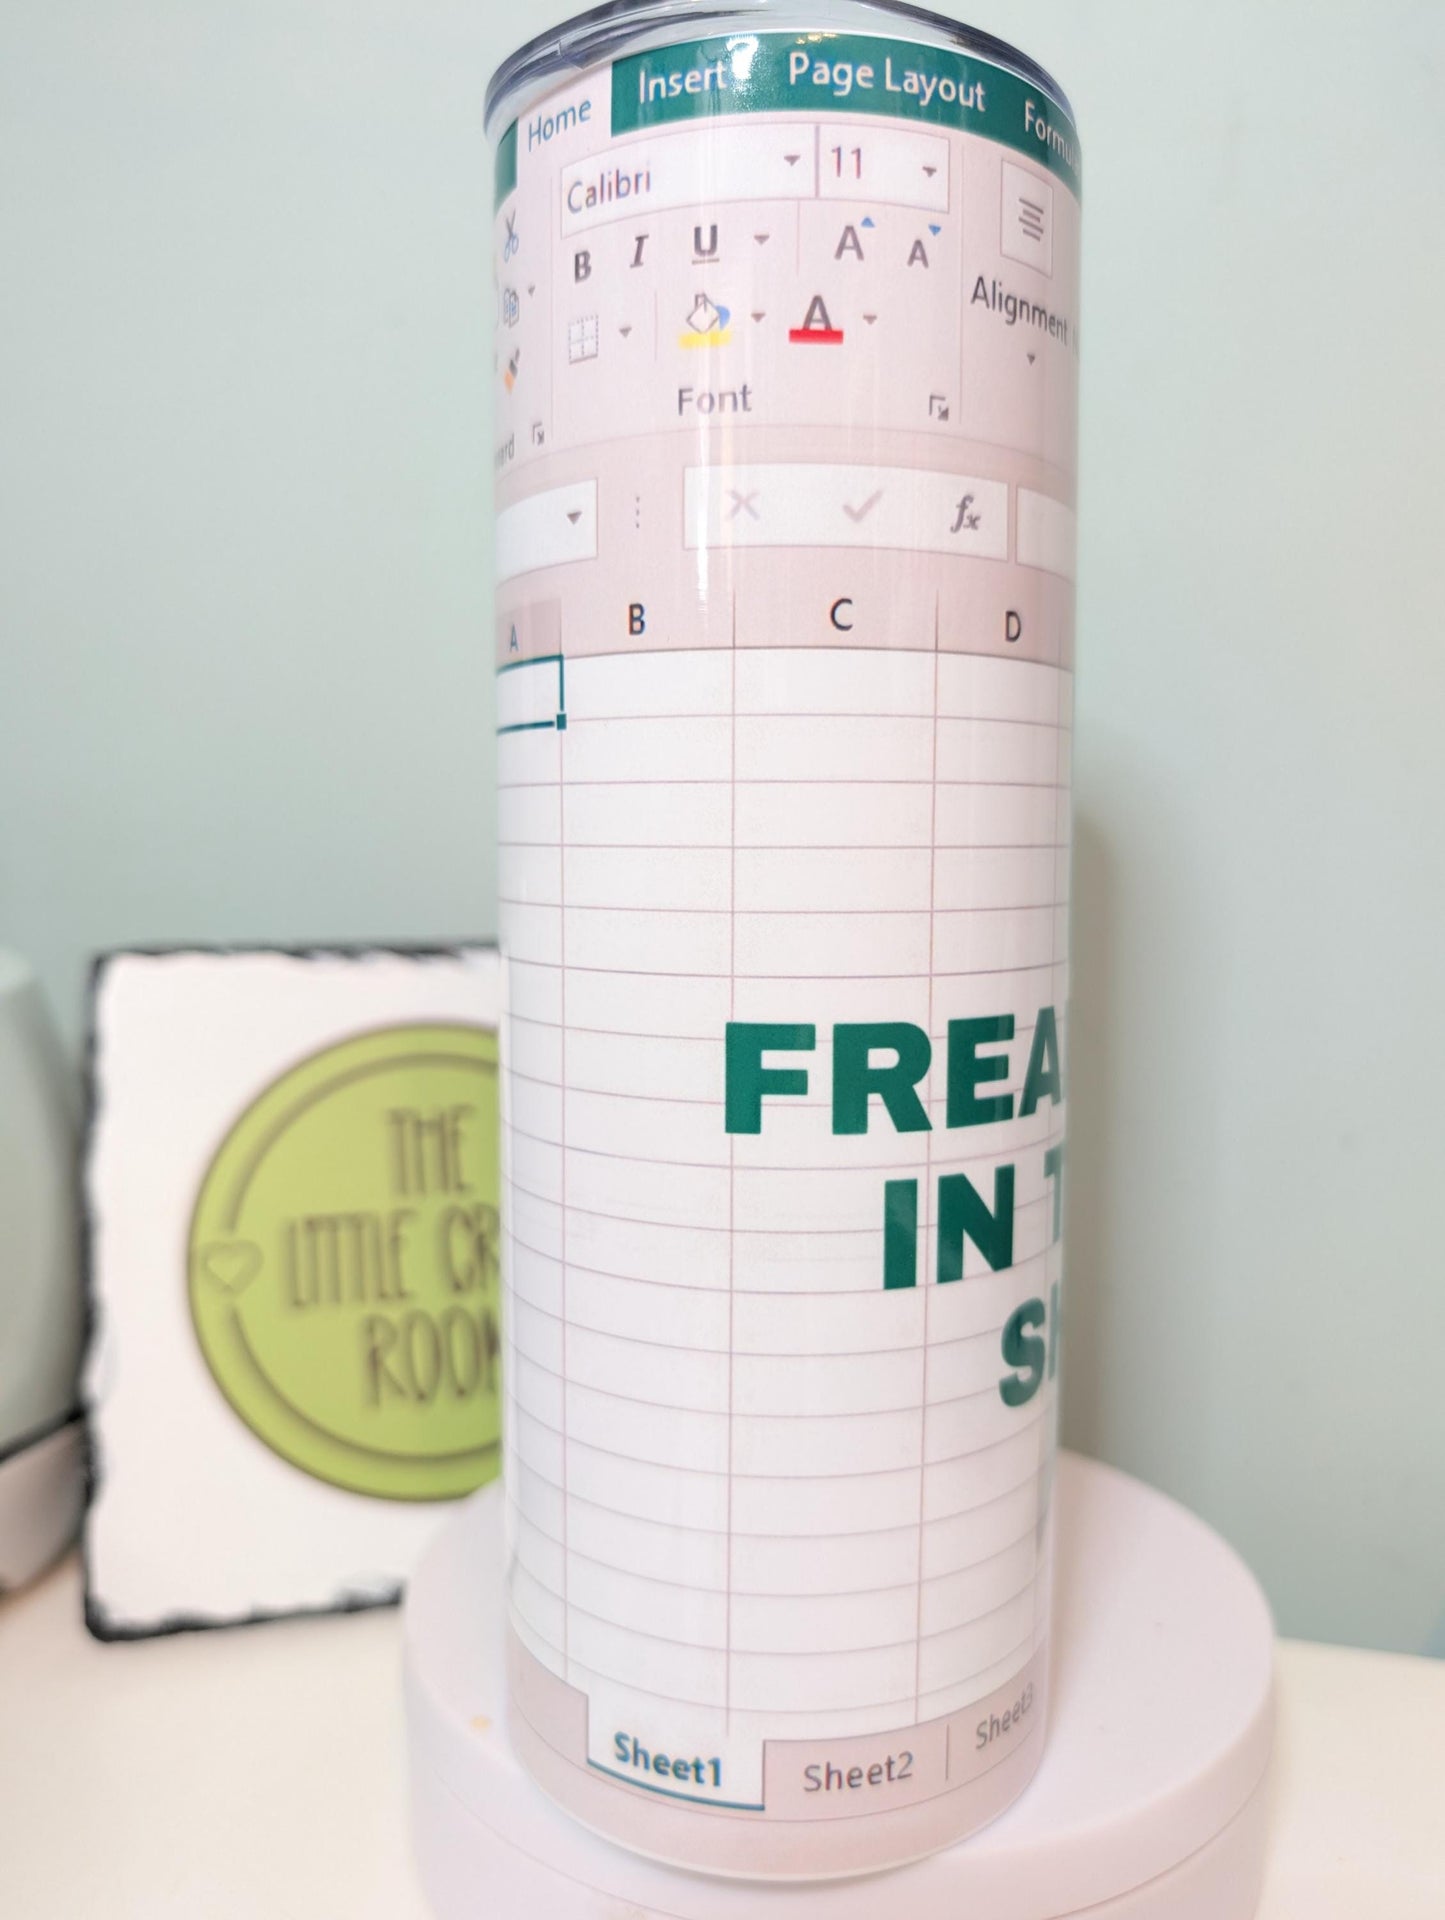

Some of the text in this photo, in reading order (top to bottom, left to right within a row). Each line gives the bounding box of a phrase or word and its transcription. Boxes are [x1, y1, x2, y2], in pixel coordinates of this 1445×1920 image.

[528, 51, 1079, 176] Home Insert Page Layout Formul
[566, 145, 864, 214] Calibri 11
[573, 223, 931, 283] B I U A A
[801, 294, 835, 331] A
[970, 274, 1068, 346] Alignment
[677, 383, 753, 416] Font
[949, 493, 981, 533] fx
[508, 597, 1023, 652] A B C D
[387, 1102, 477, 1197] THE
[283, 1207, 418, 1309] LITTLE
[883, 1163, 1016, 1291] IN
[613, 1731, 723, 1788] Sheet1
[803, 1750, 915, 1794] Sheet2
